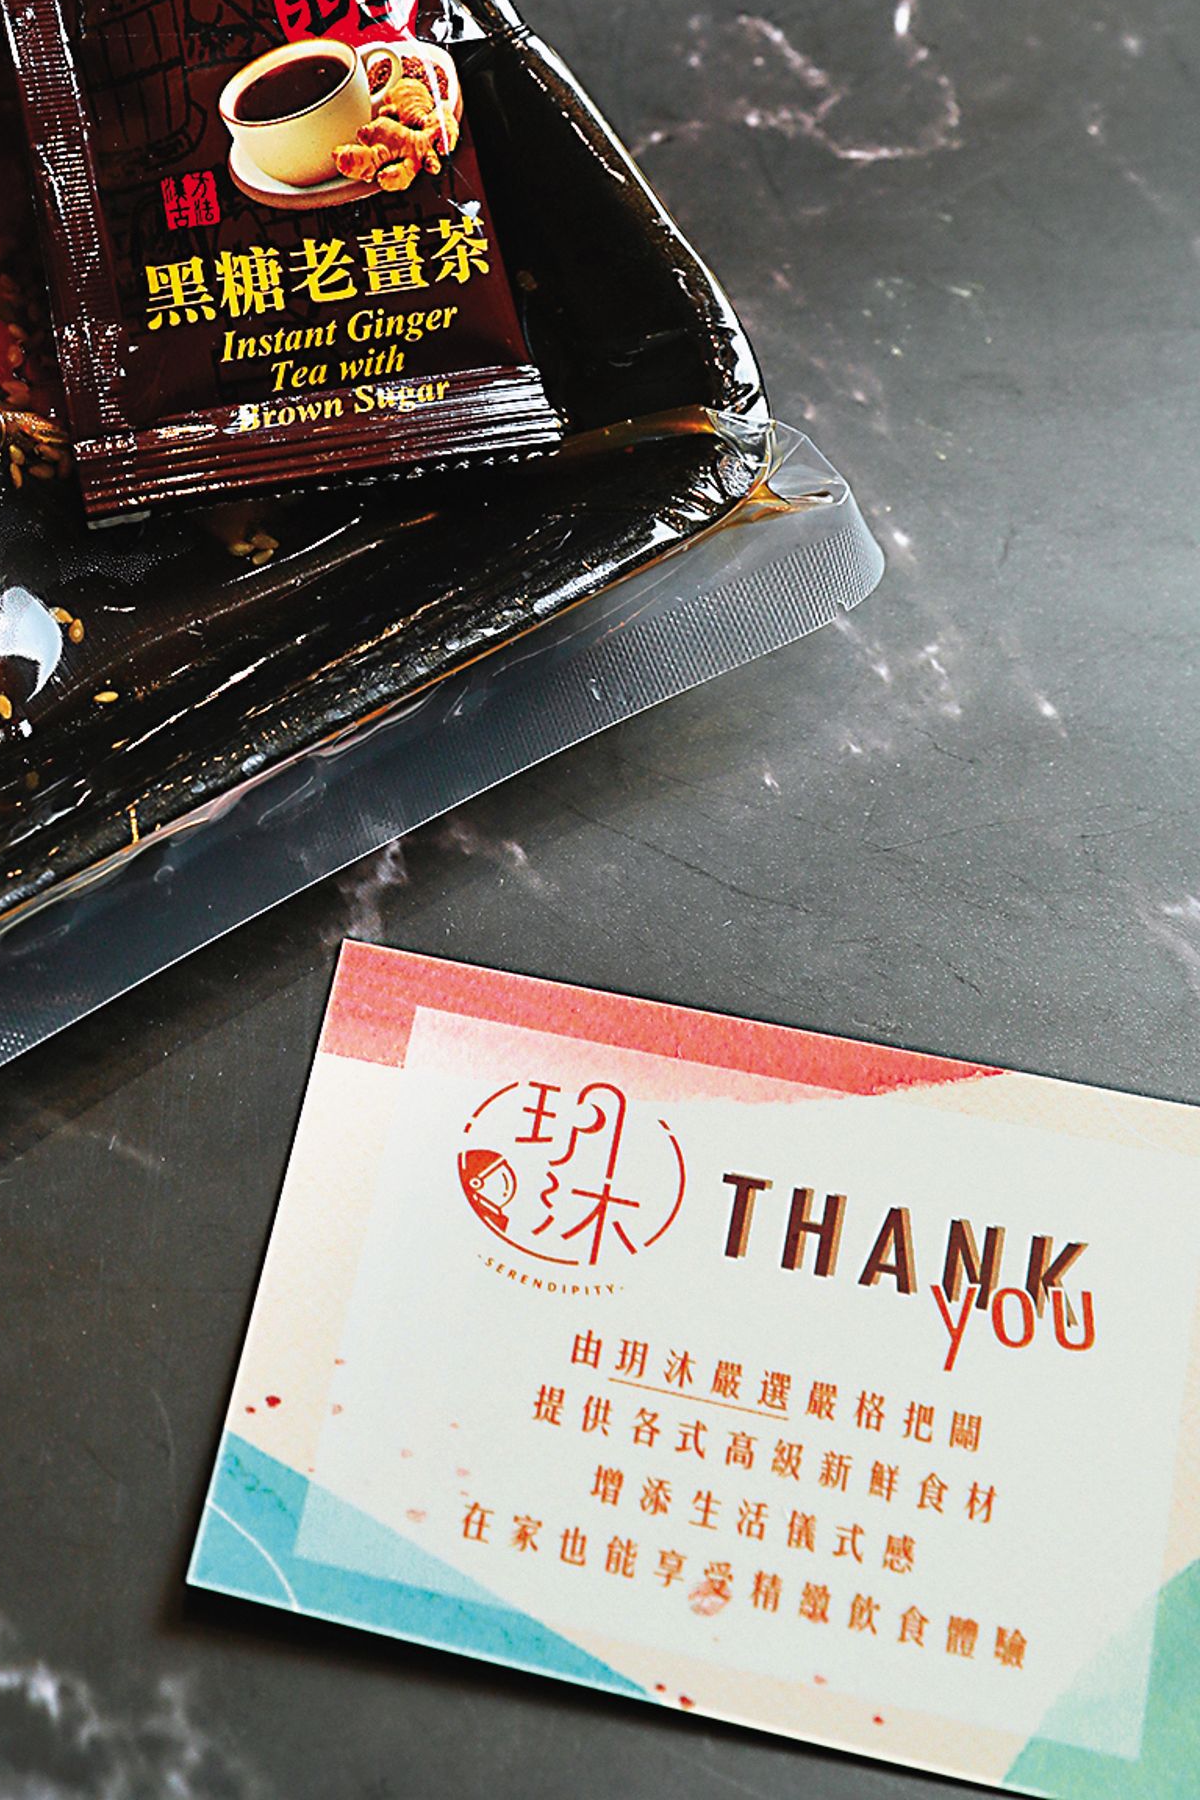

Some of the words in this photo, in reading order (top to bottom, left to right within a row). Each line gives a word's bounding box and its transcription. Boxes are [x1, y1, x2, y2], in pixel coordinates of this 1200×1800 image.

[145, 215, 490, 330] 黑糖老薑茶
[220, 319, 337, 362] Instant
[347, 307, 458, 341] Ginger
[270, 361, 327, 392] Tea
[340, 345, 404, 380] with
[240, 400, 343, 433] Brown
[354, 380, 450, 414] Sugar
[484, 1257, 615, 1295] SERENDIPITY
[723, 1172, 1089, 1328] THANK
[533, 1384, 998, 1525] 提供各式高級新鮮食材
[590, 1465, 917, 1575] 增添生活儀式感
